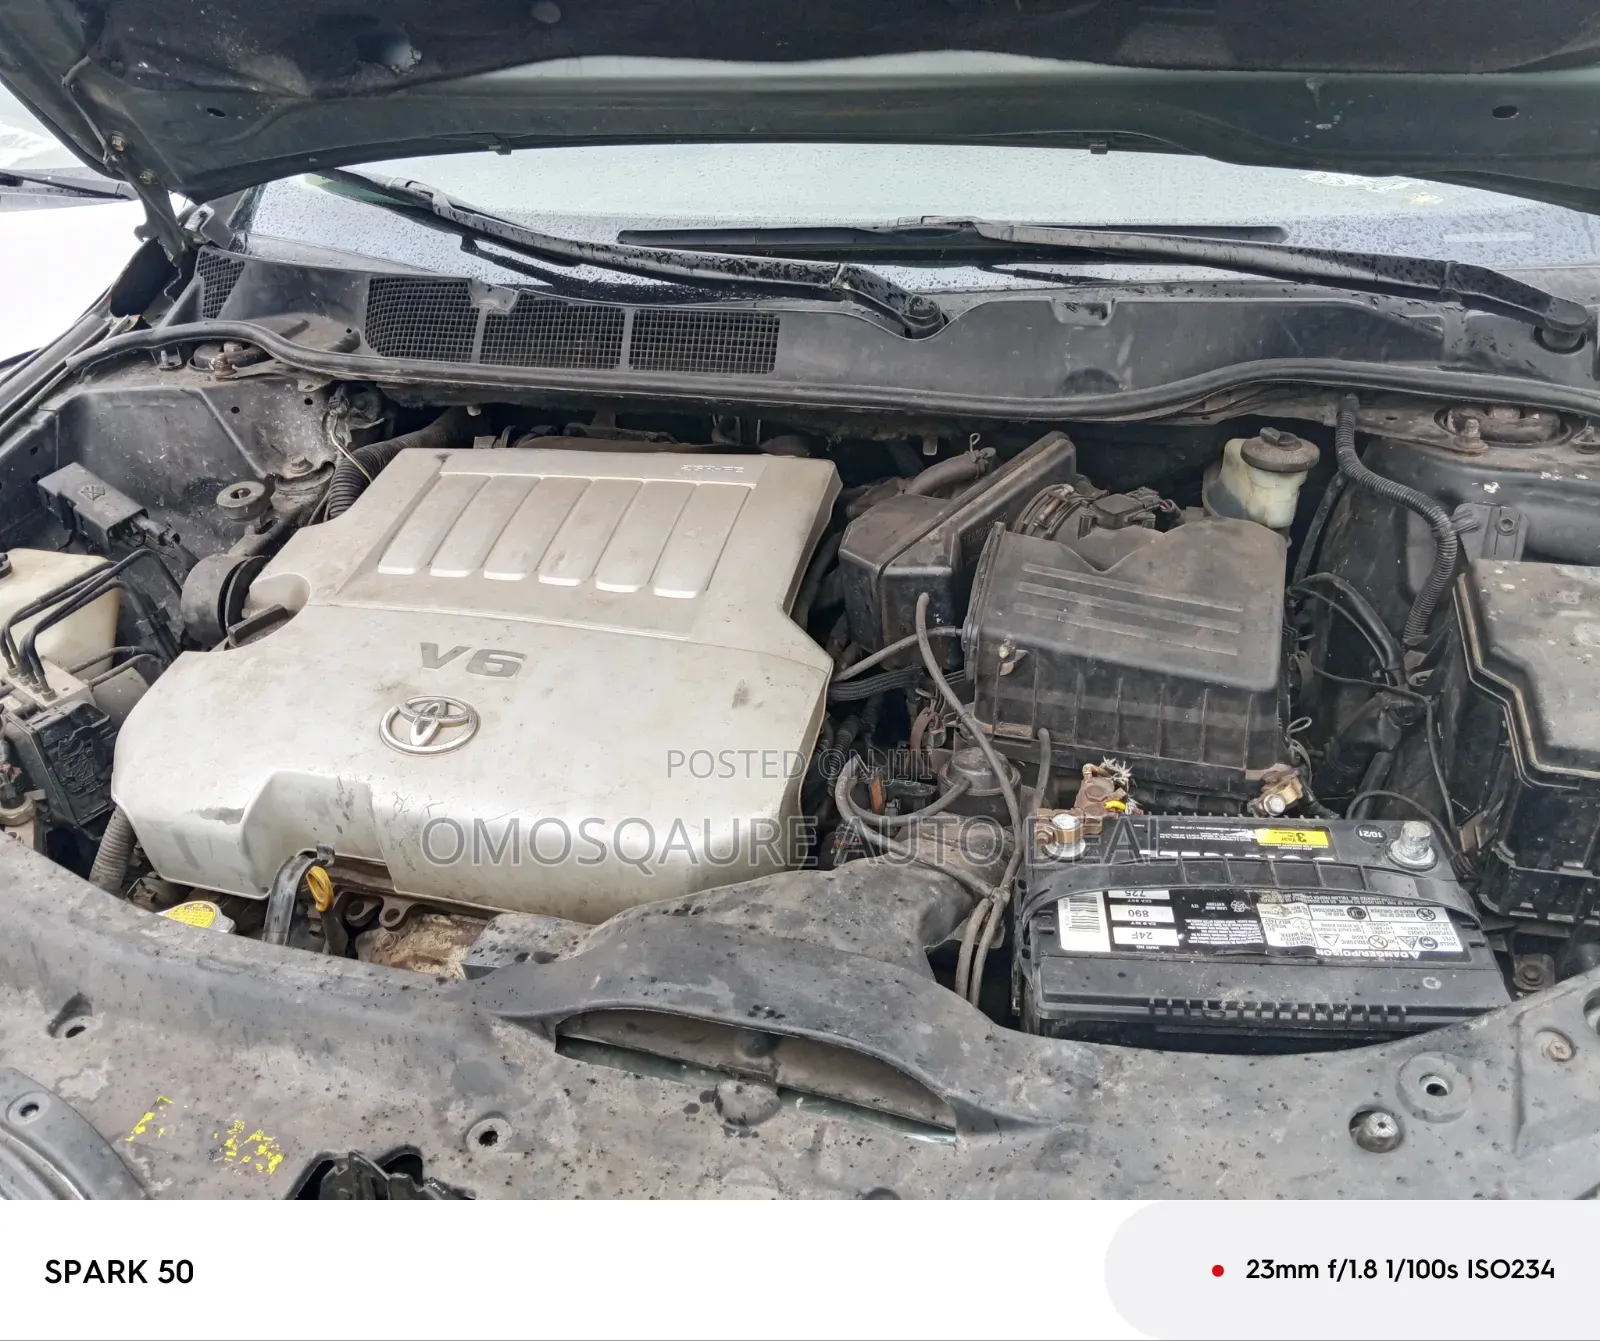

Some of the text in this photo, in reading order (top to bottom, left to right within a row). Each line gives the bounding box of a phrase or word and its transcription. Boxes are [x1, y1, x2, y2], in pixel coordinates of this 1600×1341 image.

[420, 641, 527, 679] V6
[1295, 832, 1307, 843] 3
[1359, 830, 1384, 838] 10/21
[1124, 890, 1146, 898] 725
[1127, 909, 1149, 917] 890
[1131, 931, 1153, 940] 24F
[1315, 949, 1409, 958] DANGER/POISON
